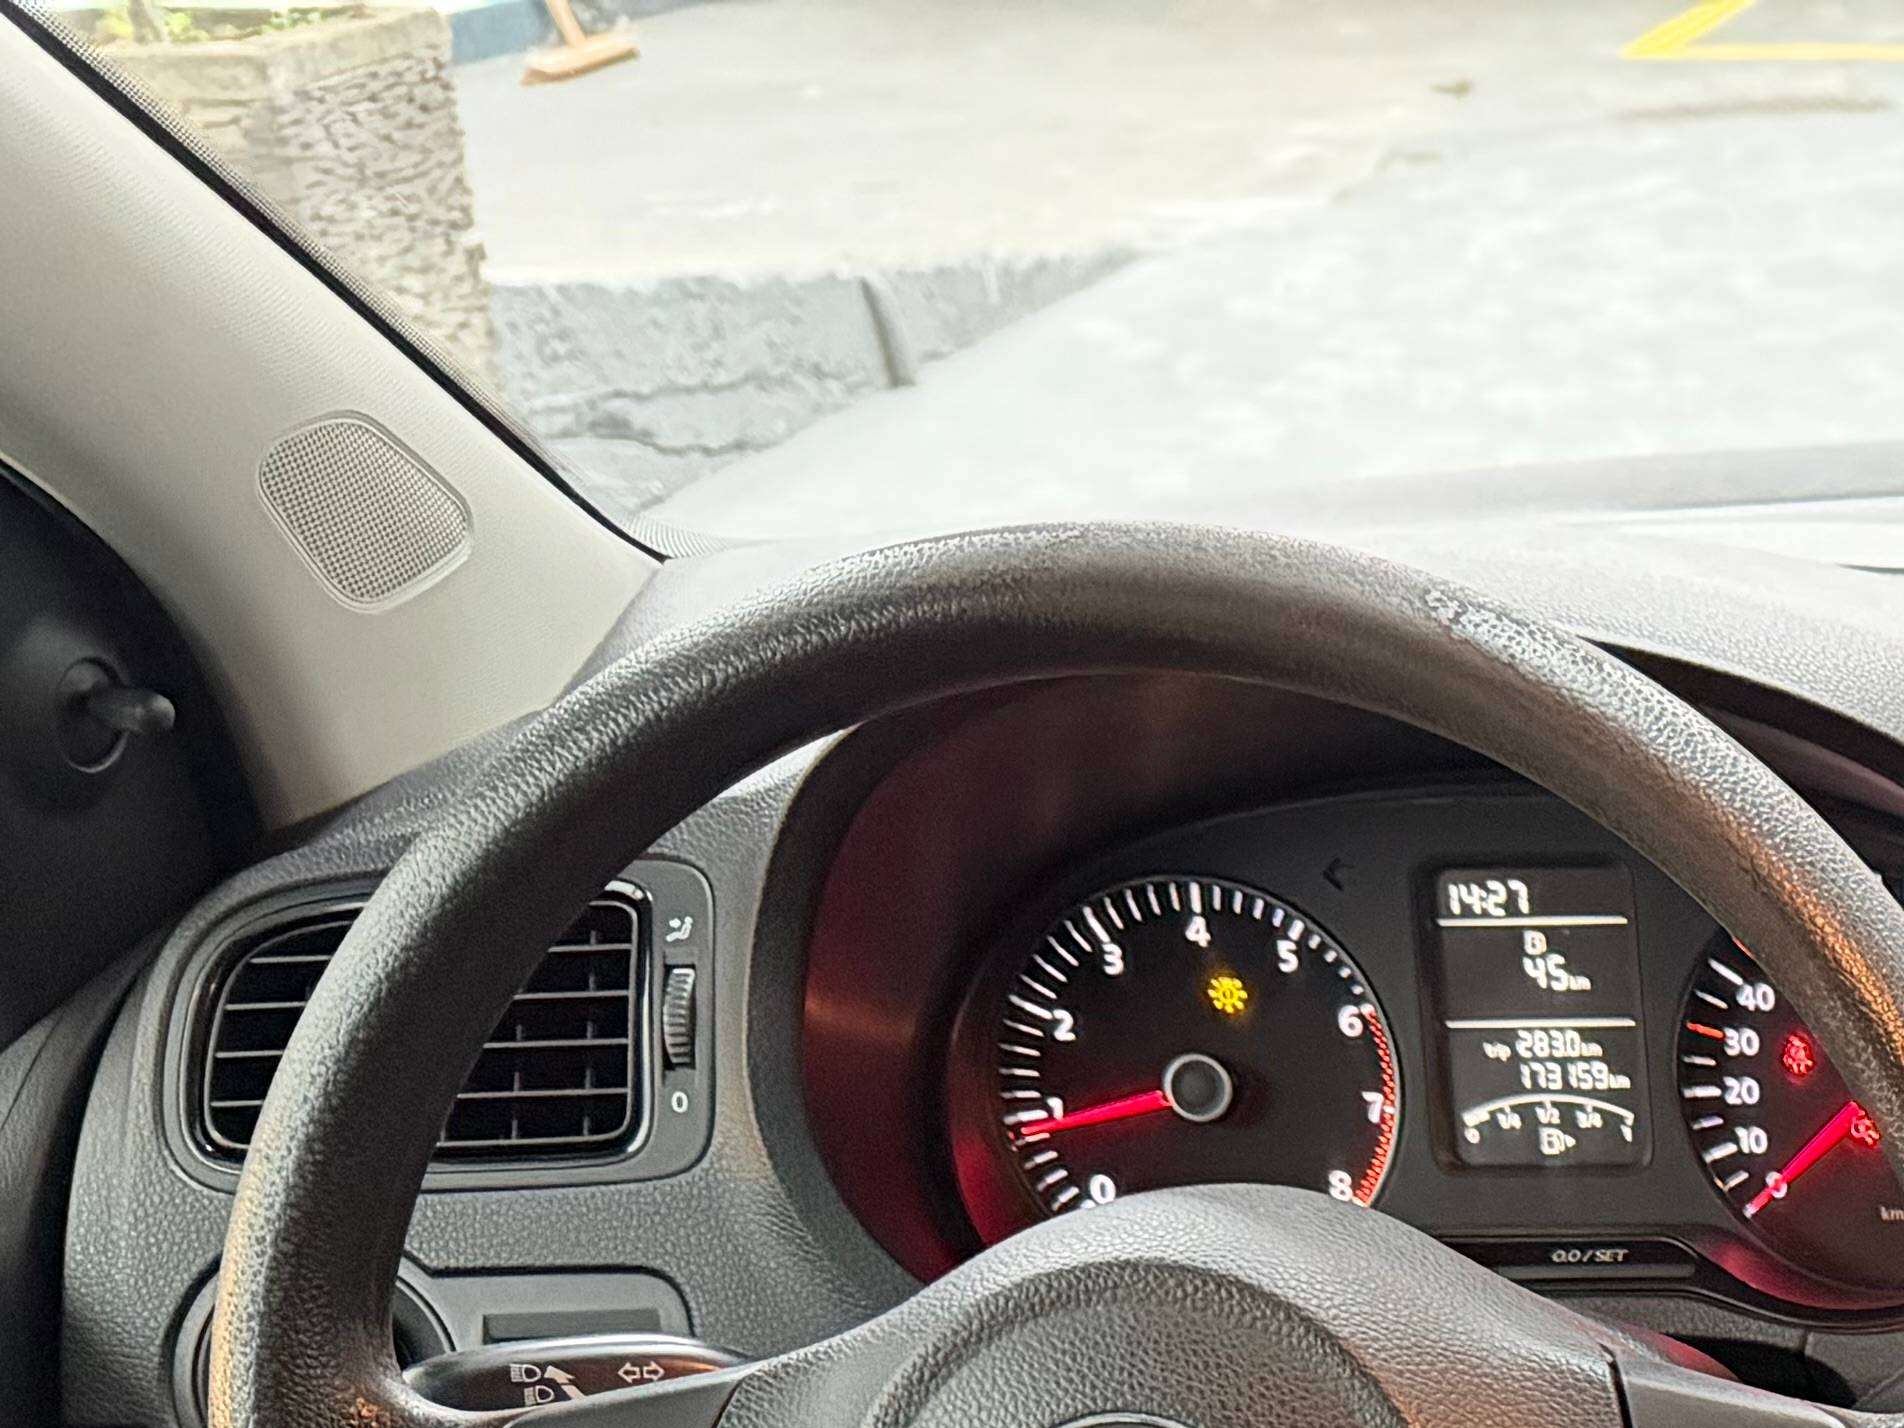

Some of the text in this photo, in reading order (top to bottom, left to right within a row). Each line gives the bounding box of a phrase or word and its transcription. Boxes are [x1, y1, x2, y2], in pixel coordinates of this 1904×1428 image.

[1449, 879, 1530, 917] 14:27
[1185, 915, 1212, 948] 4
[1102, 942, 1125, 976] 3
[1277, 939, 1299, 973] 5
[1736, 982, 1776, 1012] 40
[1052, 1009, 1077, 1041] 2
[1338, 1004, 1363, 1038] 6
[1723, 1026, 1760, 1057] 30
[671, 1091, 688, 1113] 0
[1723, 1075, 1760, 1106] 20
[1361, 1090, 1384, 1124] 7
[1735, 1126, 1768, 1155] 10
[1089, 1173, 1117, 1204] 0
[1328, 1169, 1352, 1201] 8
